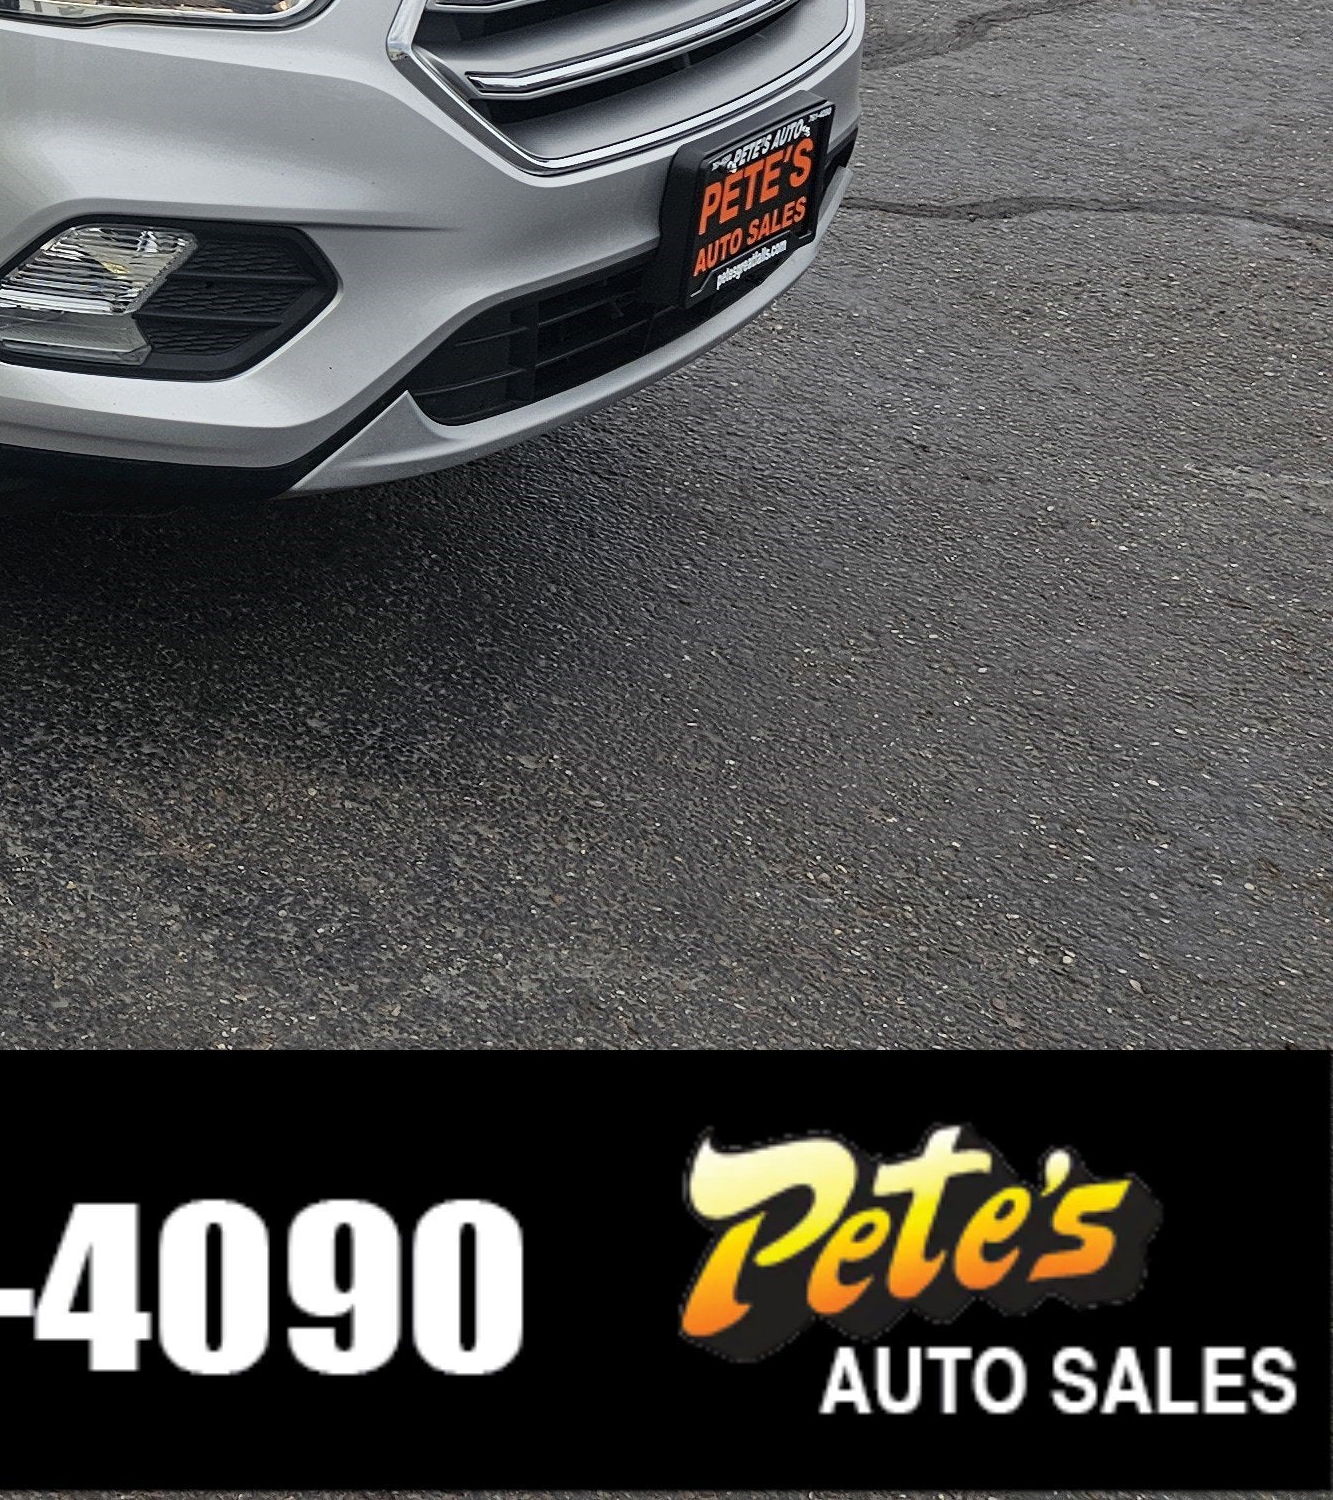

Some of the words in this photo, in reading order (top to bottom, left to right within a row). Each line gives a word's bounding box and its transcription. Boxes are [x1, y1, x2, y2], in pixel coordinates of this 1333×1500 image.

[733, 133, 773, 167] PETE'S
[771, 118, 804, 150] AUTO
[699, 138, 814, 235] PETE'S
[693, 227, 744, 276] AUTO
[746, 196, 807, 246] SALES
